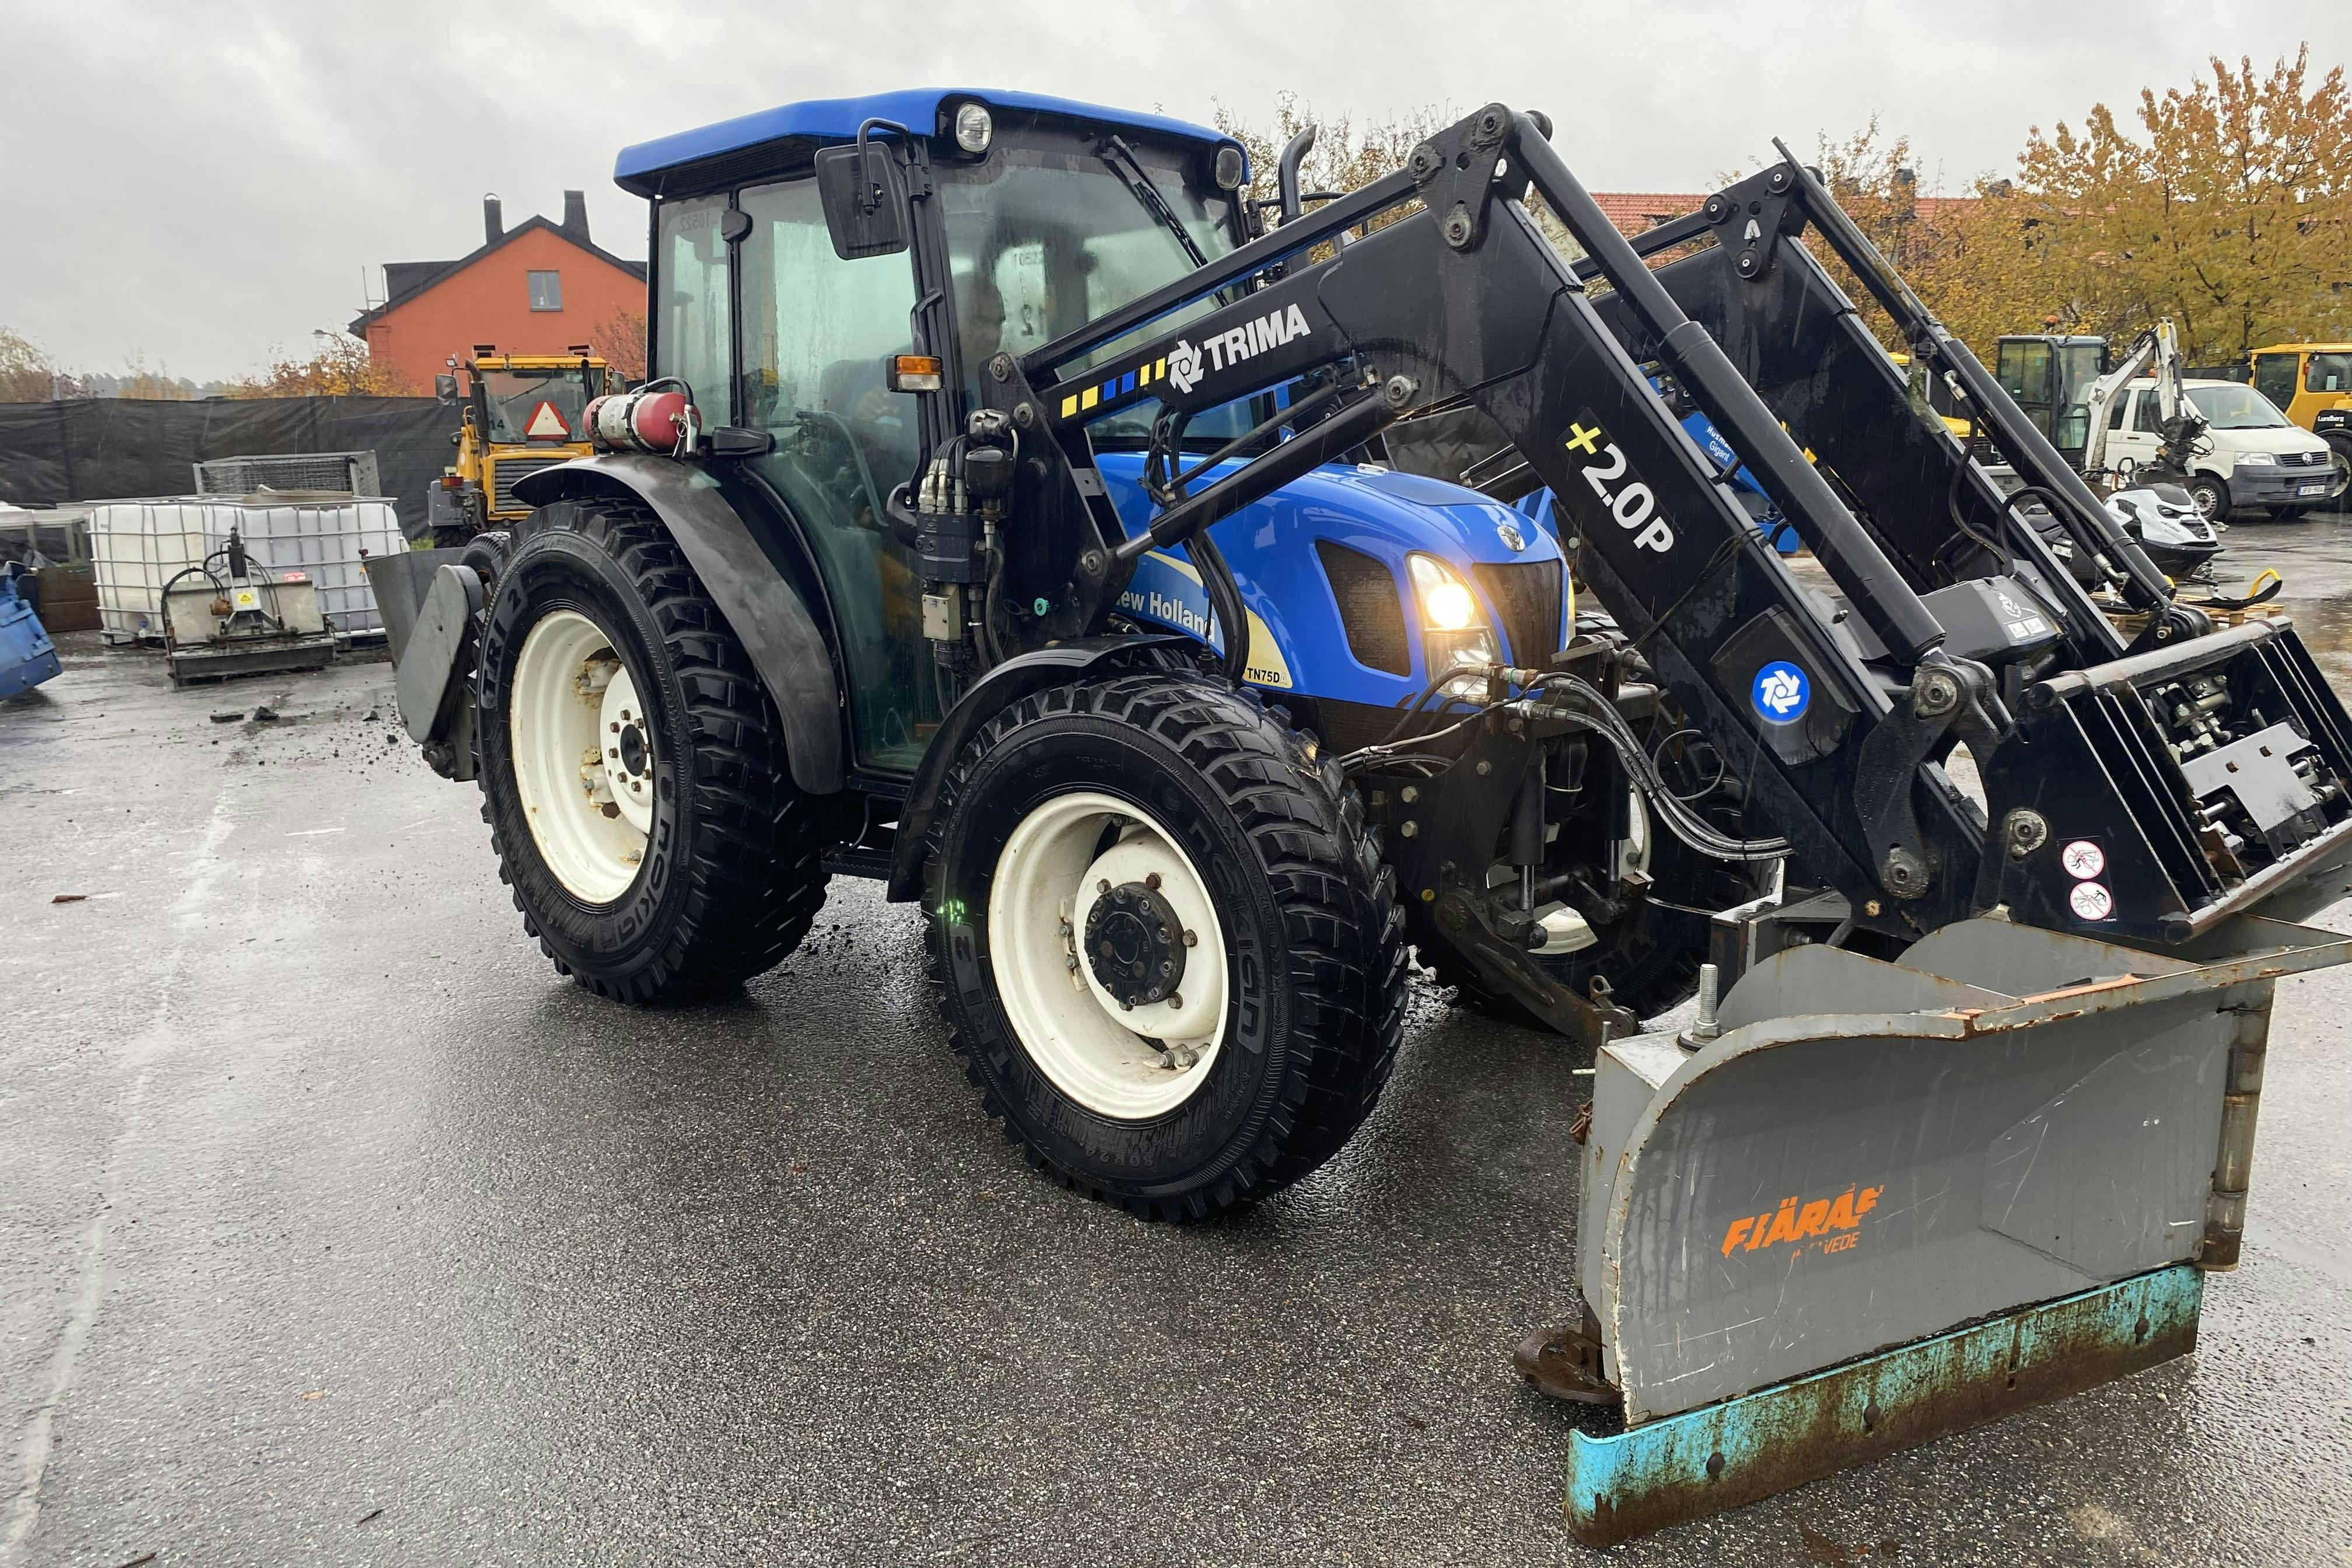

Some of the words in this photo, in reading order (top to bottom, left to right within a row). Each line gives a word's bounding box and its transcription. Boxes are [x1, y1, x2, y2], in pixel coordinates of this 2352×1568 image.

[1204, 303, 1311, 372] TRIMA
[489, 419, 505, 430] 14
[1709, 440, 1730, 462] Gigant
[1149, 591, 1215, 643] Holland
